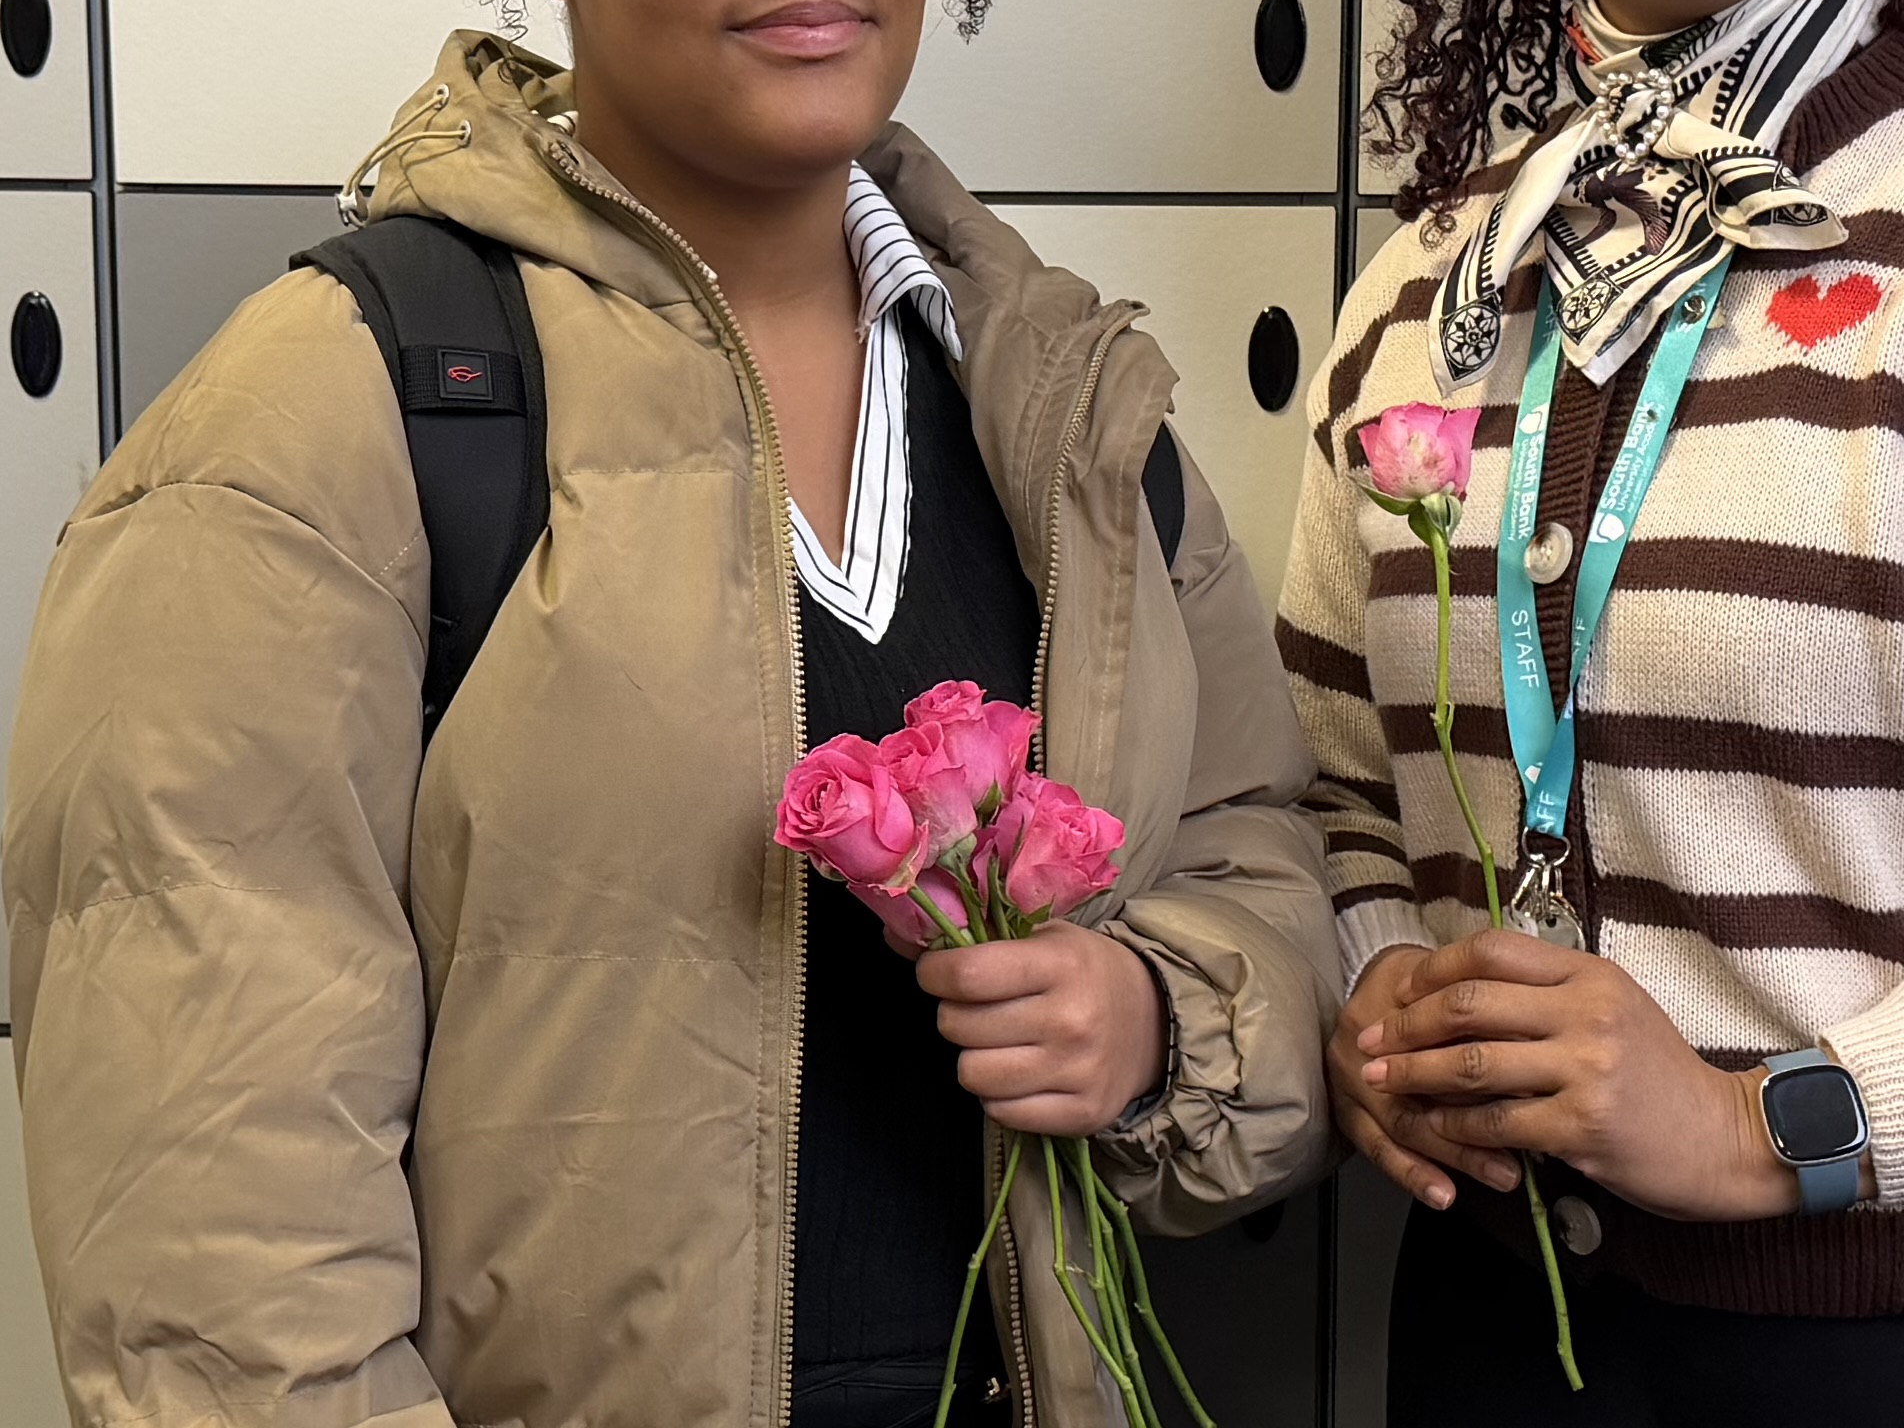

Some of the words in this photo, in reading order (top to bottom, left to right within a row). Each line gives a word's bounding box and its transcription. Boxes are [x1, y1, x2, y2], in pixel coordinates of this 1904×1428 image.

[1521, 434, 1544, 487] South
[1599, 453, 1633, 508] South
[1622, 401, 1654, 447] Bank
[1615, 455, 1644, 510] University
[1517, 492, 1535, 539] Bank
[1511, 609, 1540, 689] STAFF
